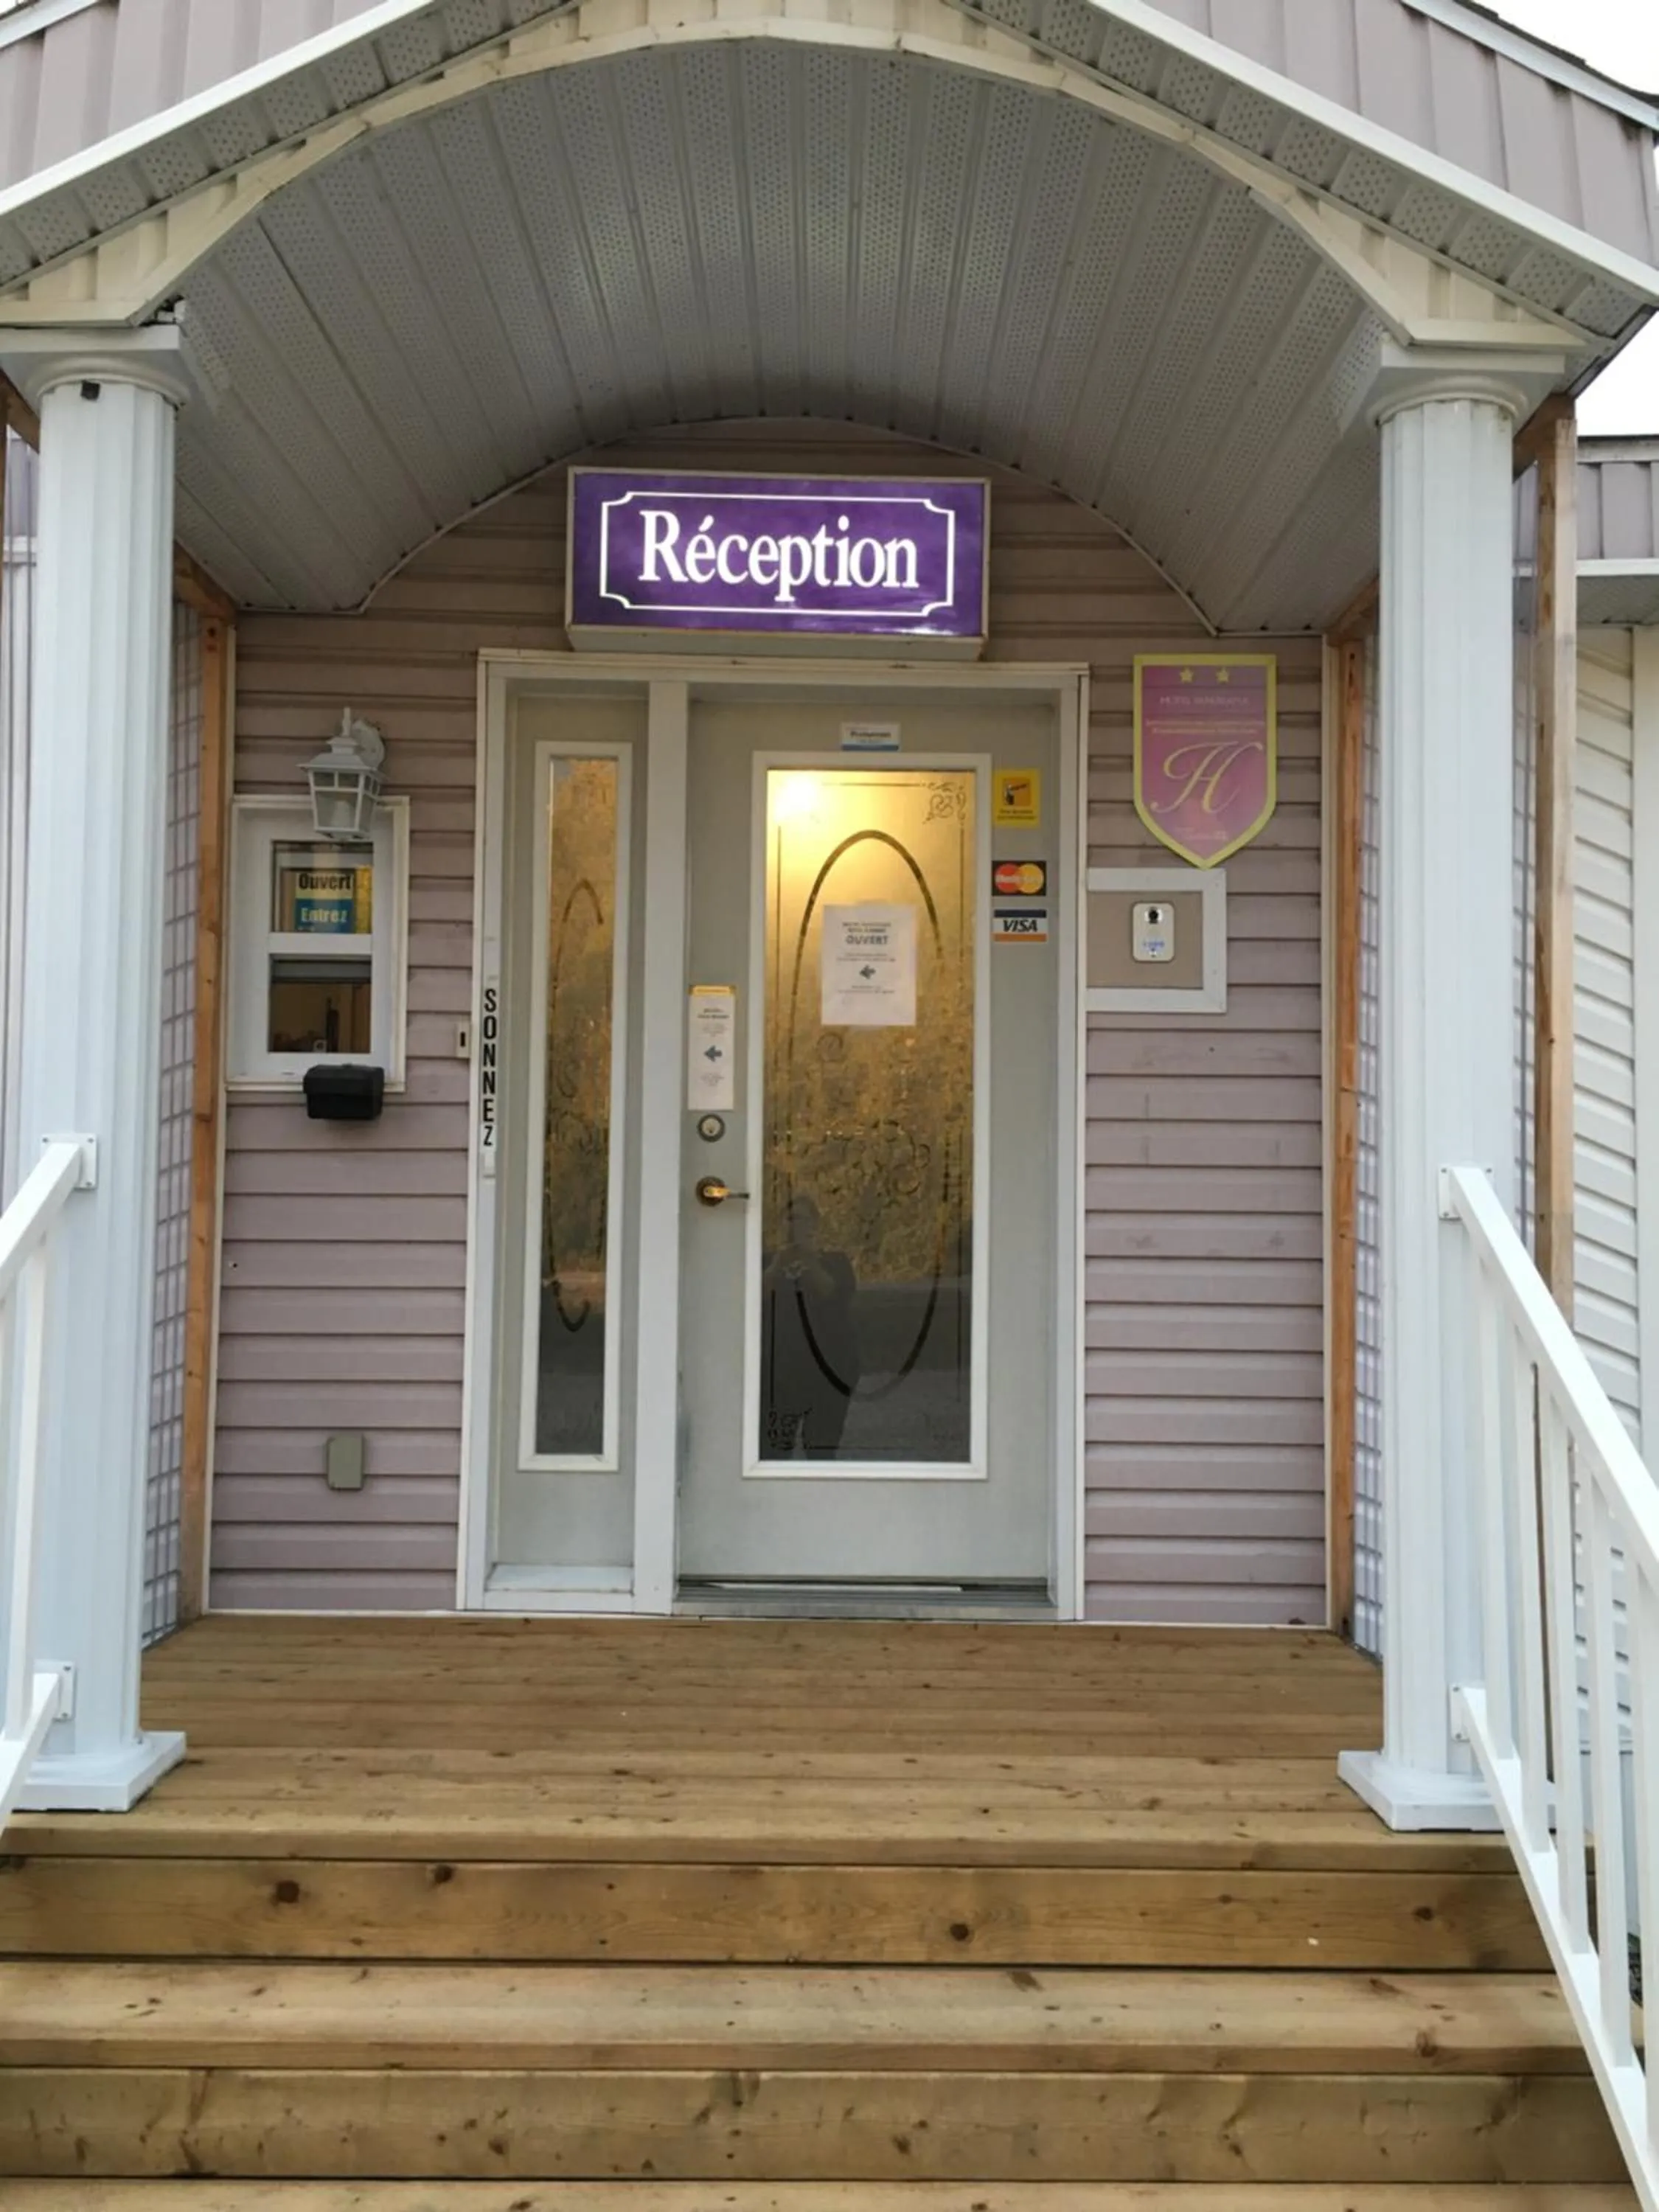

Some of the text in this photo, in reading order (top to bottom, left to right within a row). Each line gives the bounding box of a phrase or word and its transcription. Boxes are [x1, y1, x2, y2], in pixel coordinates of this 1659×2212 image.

[639, 509, 919, 602] Réception
[1150, 740, 1264, 814] H
[299, 873, 352, 890] Ouvert
[300, 908, 348, 923] Entrez
[1003, 919, 1038, 933] VISA
[846, 935, 888, 945] OUVERT
[482, 988, 498, 1146] SONNEZ
